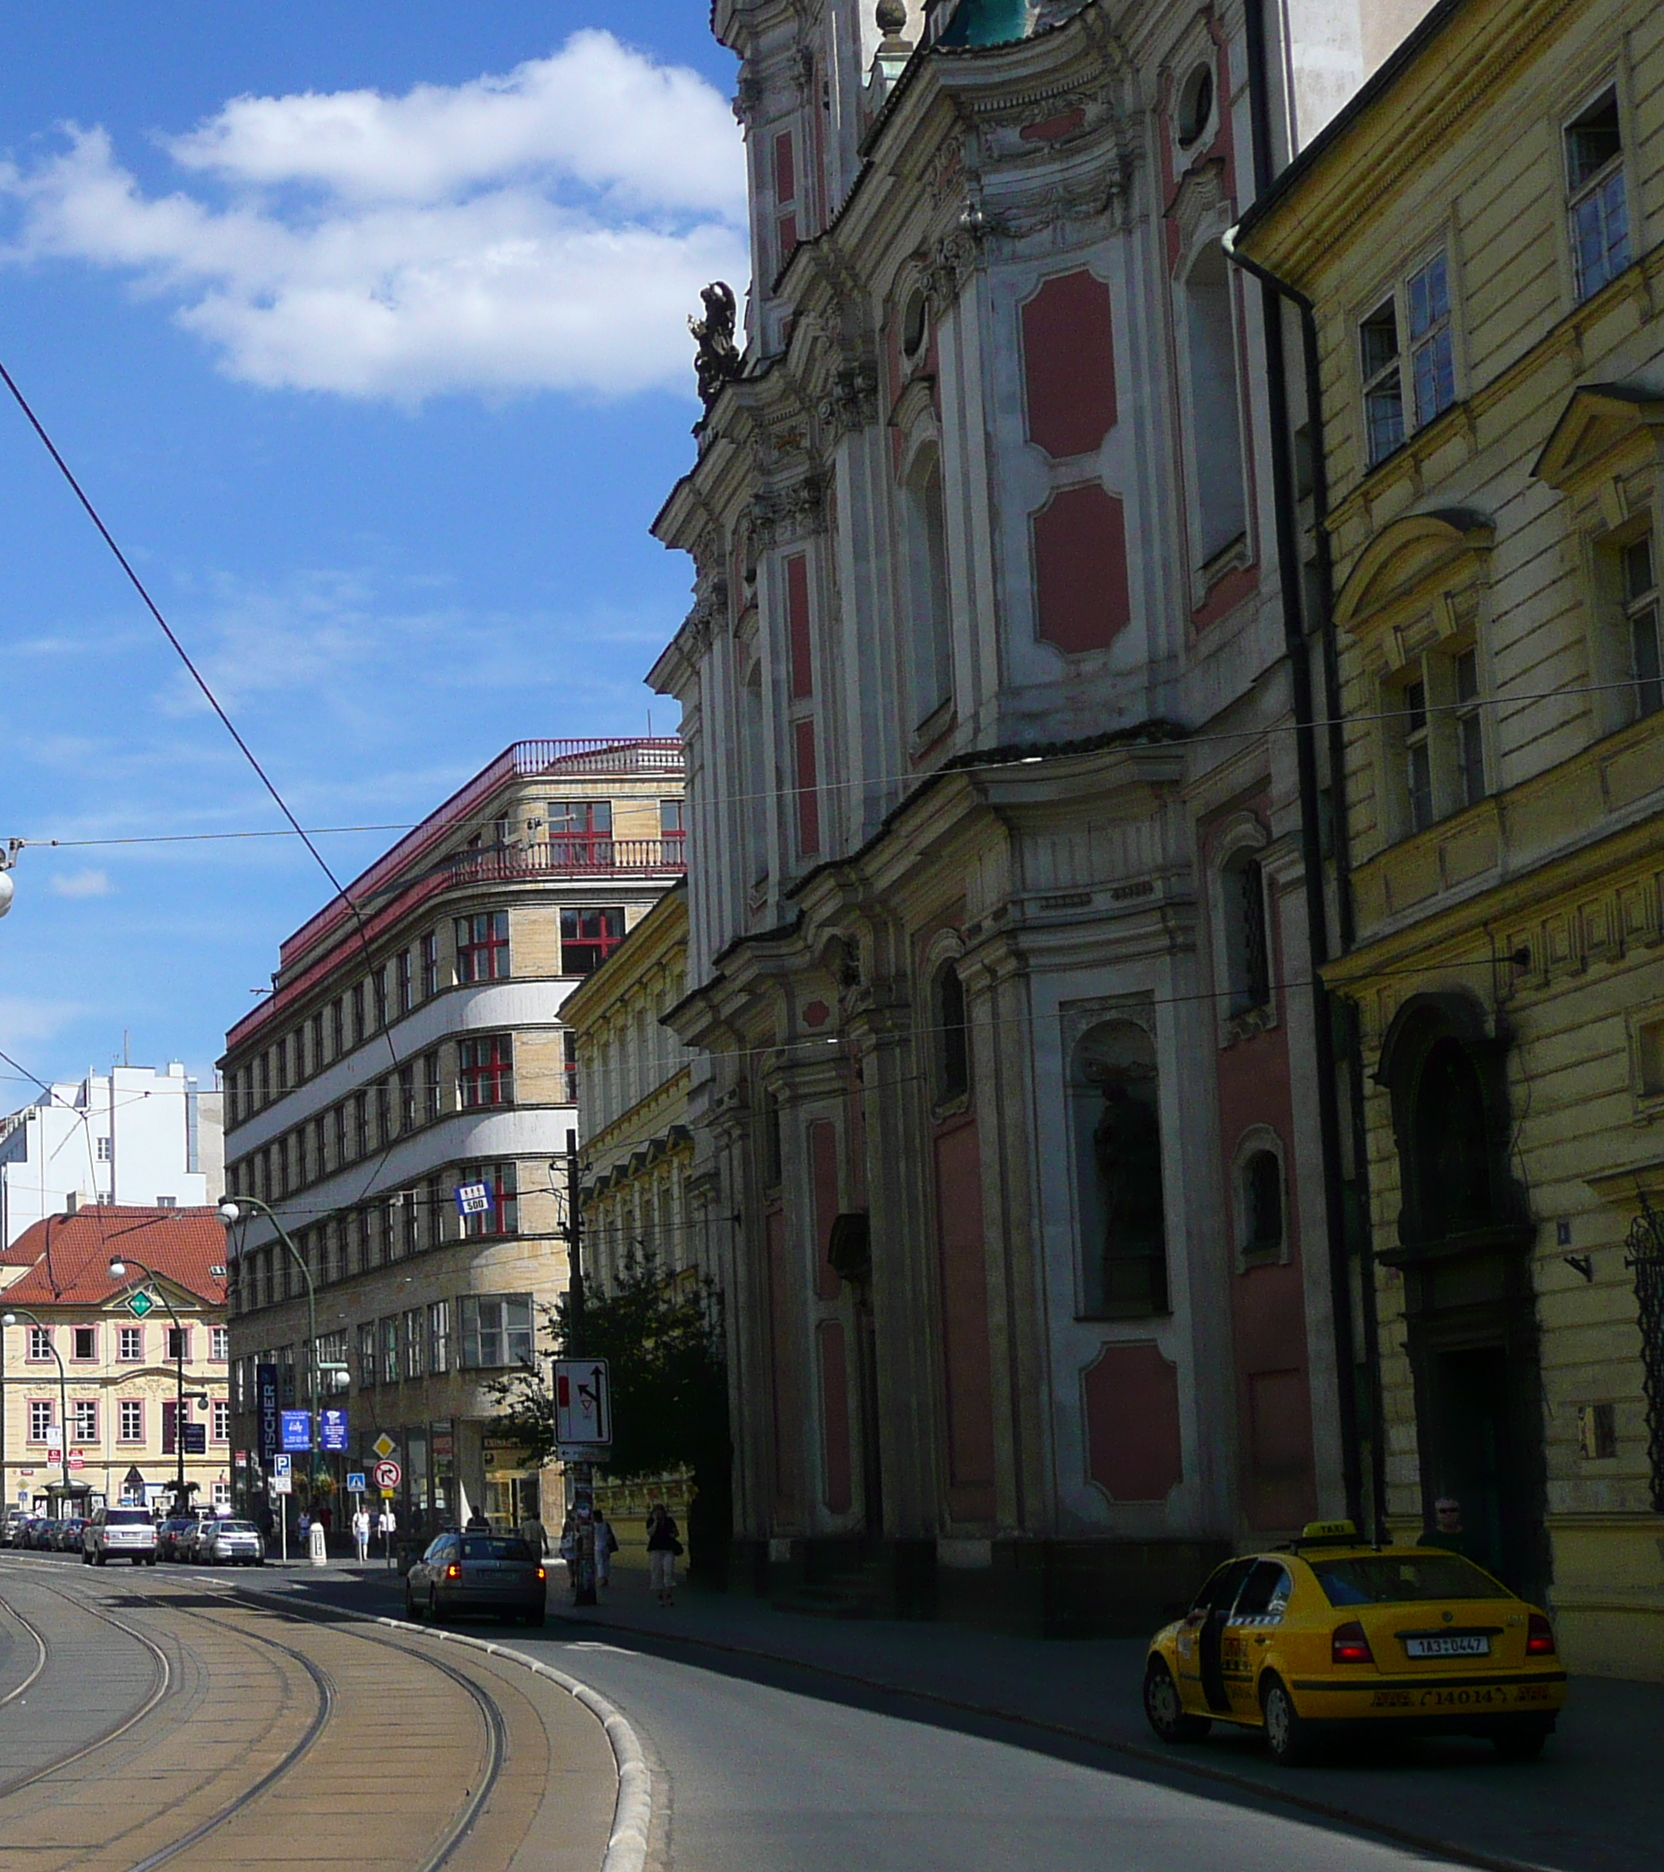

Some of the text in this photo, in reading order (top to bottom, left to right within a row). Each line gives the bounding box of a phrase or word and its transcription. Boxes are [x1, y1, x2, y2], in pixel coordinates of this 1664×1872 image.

[264, 1384, 277, 1459] FISCHER
[277, 1457, 288, 1471] P
[1320, 1524, 1345, 1535] TAXI
[1419, 1638, 1482, 1653] 1A3 0447
